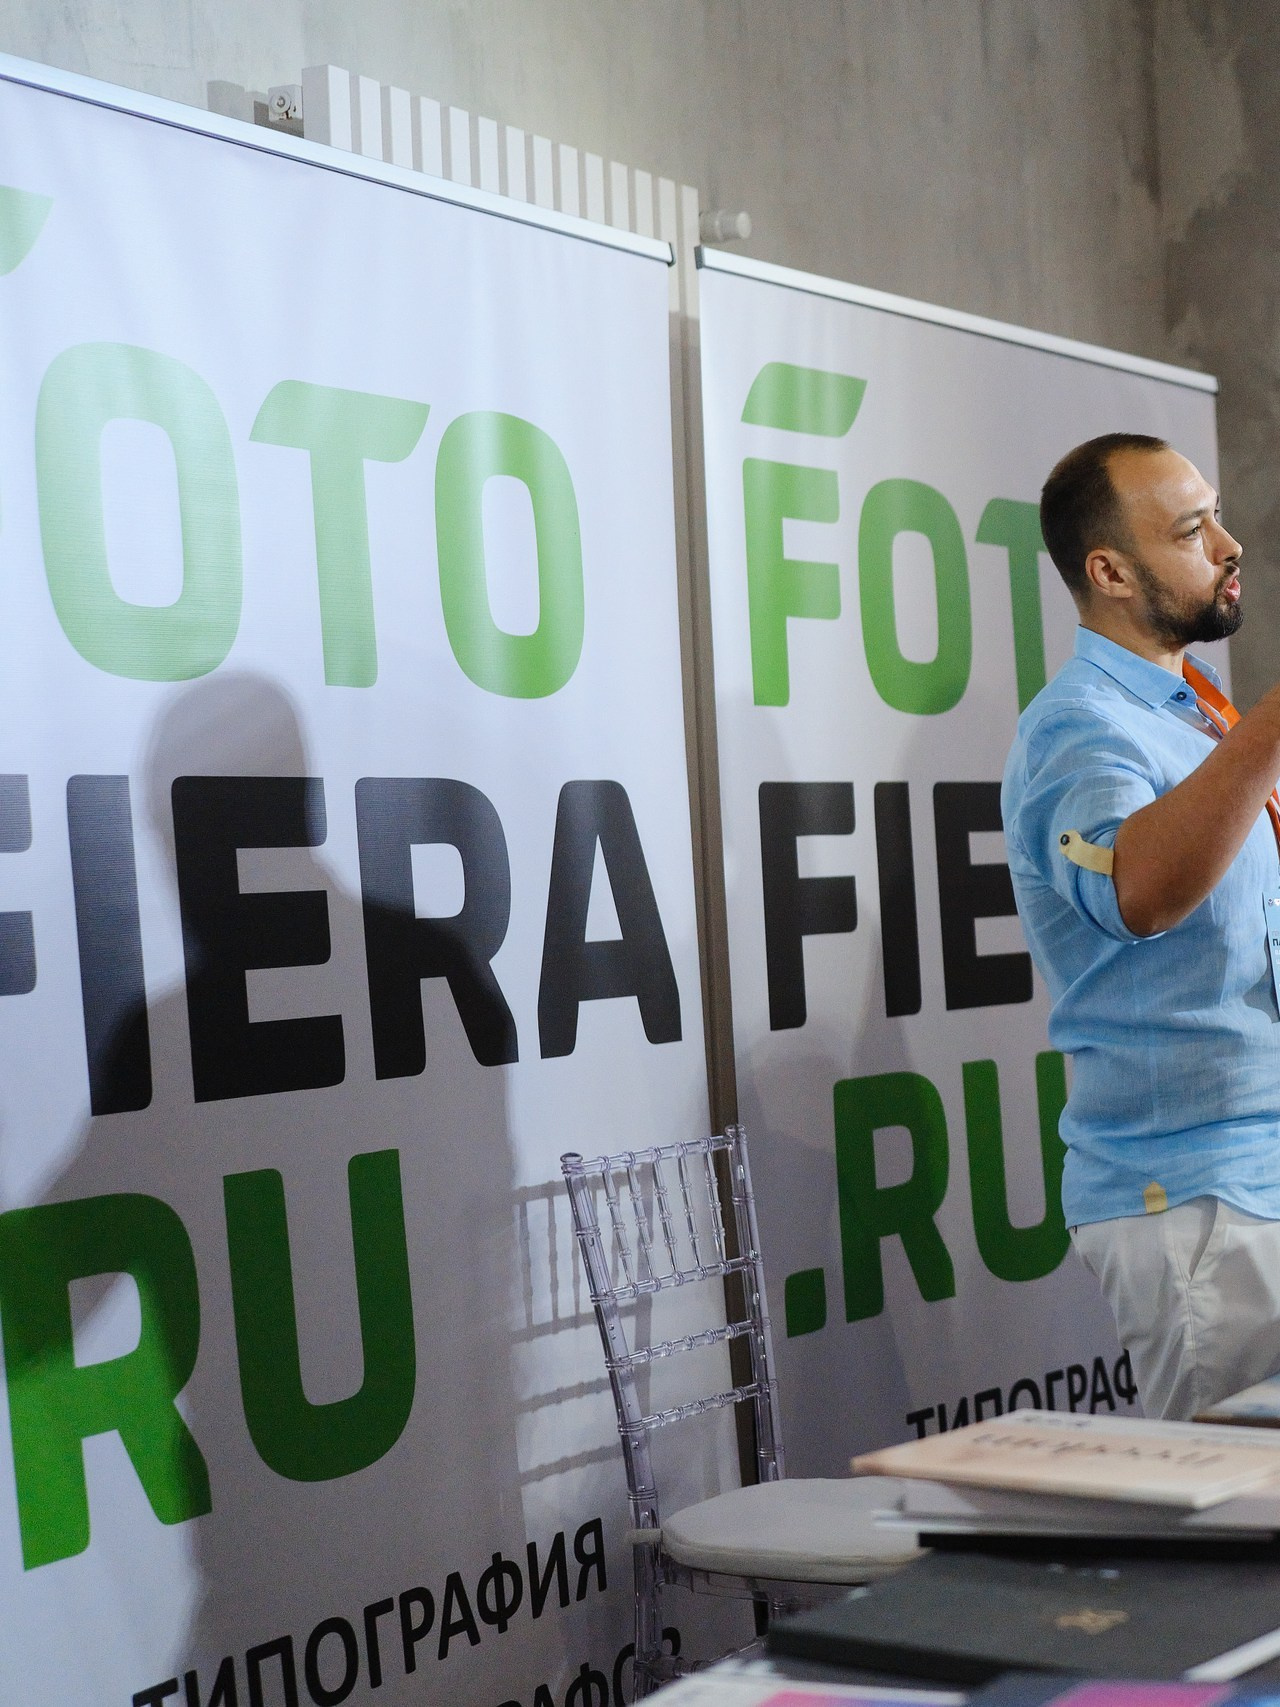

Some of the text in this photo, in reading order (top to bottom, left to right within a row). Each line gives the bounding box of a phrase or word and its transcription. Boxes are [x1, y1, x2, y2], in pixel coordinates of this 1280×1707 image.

[0, 342, 585, 699] OTO
[741, 362, 1047, 714] FOT
[758, 781, 1034, 1031] FIE
[785, 1051, 1073, 1339] .RU
[906, 1348, 1138, 1439] ТИПОГРАФ
